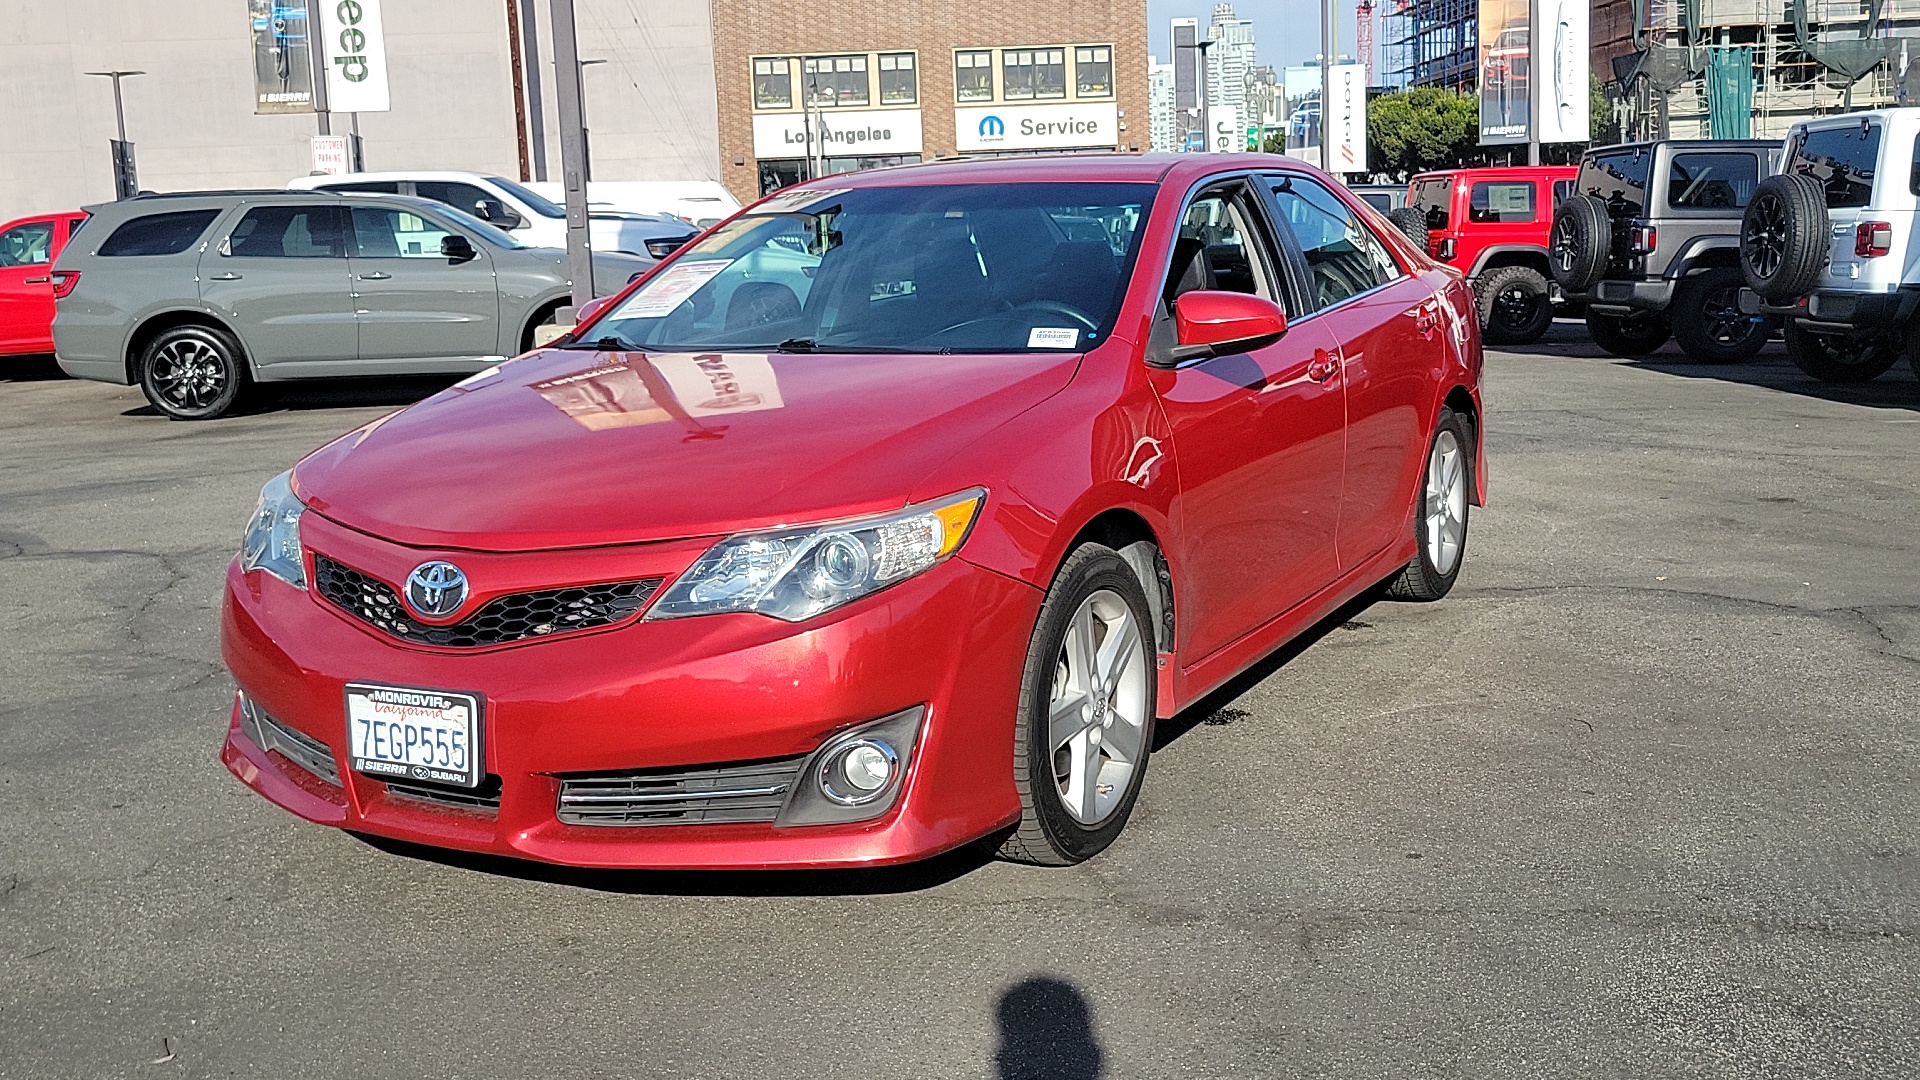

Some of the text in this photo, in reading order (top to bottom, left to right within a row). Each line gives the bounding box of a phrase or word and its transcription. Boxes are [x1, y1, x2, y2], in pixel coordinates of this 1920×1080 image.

[822, 126, 891, 145] Angeles
[1020, 117, 1098, 136] Service
[315, 140, 343, 149] CUSTOMER
[1216, 121, 1234, 153] Je
[318, 153, 342, 162] PARKING
[374, 690, 444, 708] MONROVIA
[358, 718, 465, 769] 7EGP555
[364, 761, 466, 783] SIERRA SUBARU
